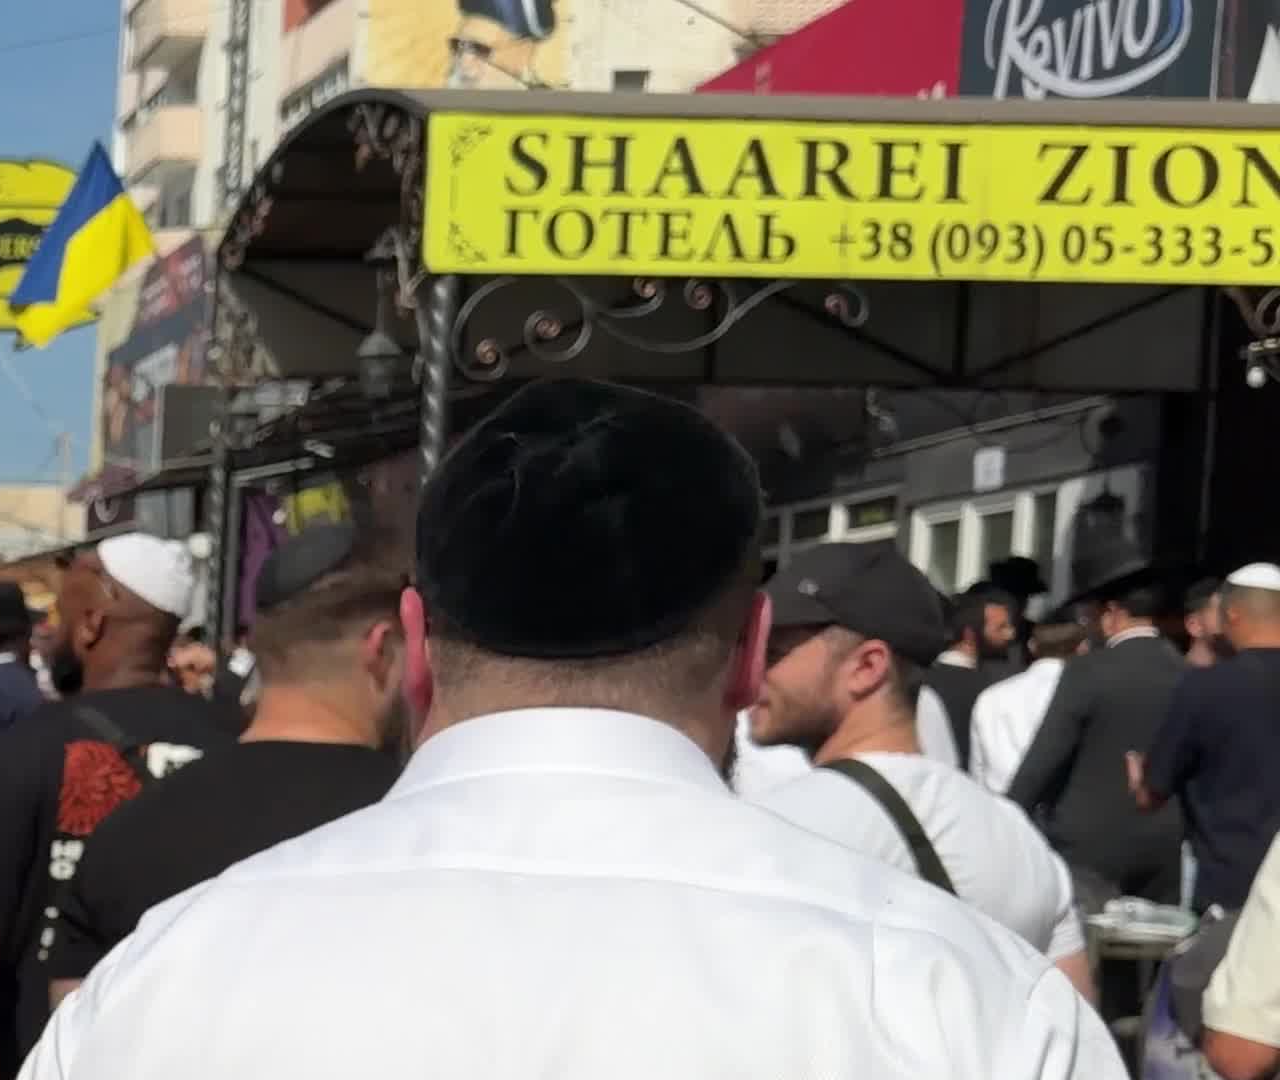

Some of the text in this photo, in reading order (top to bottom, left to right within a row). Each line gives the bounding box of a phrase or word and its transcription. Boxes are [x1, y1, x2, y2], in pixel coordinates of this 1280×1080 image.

[985, 0, 1162, 99] Revivo
[504, 128, 1280, 209] SHAAREI ZION
[503, 207, 1280, 278] ГОТЕЛЬ +38 (093) 05-333-5
